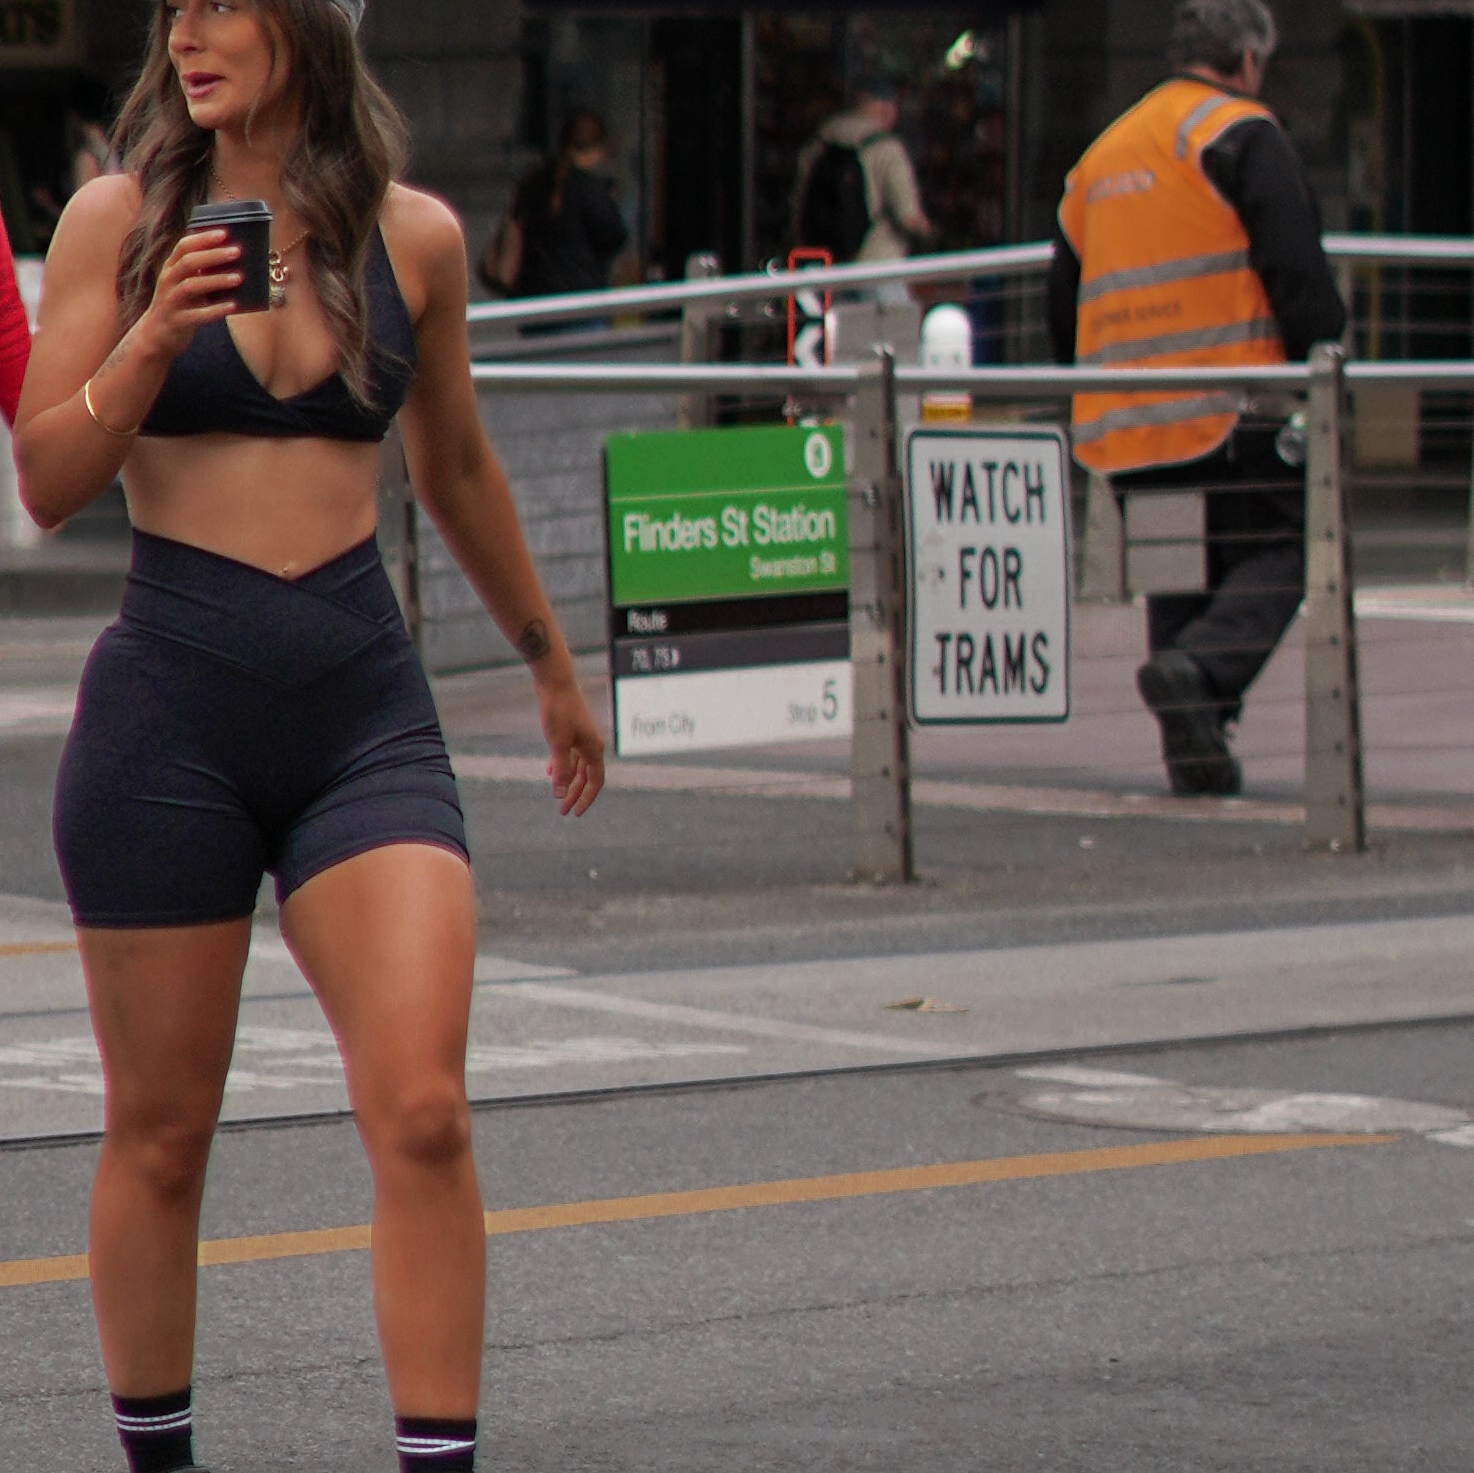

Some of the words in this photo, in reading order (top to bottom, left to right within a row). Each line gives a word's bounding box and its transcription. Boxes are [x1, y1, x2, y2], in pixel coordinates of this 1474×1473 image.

[930, 460, 1045, 524] WATCH
[624, 510, 719, 553] Flinders
[721, 505, 749, 547] St
[752, 501, 836, 545] Station
[959, 546, 1023, 610] FOR
[934, 630, 1050, 696] TRAMS
[822, 679, 839, 721] 5
